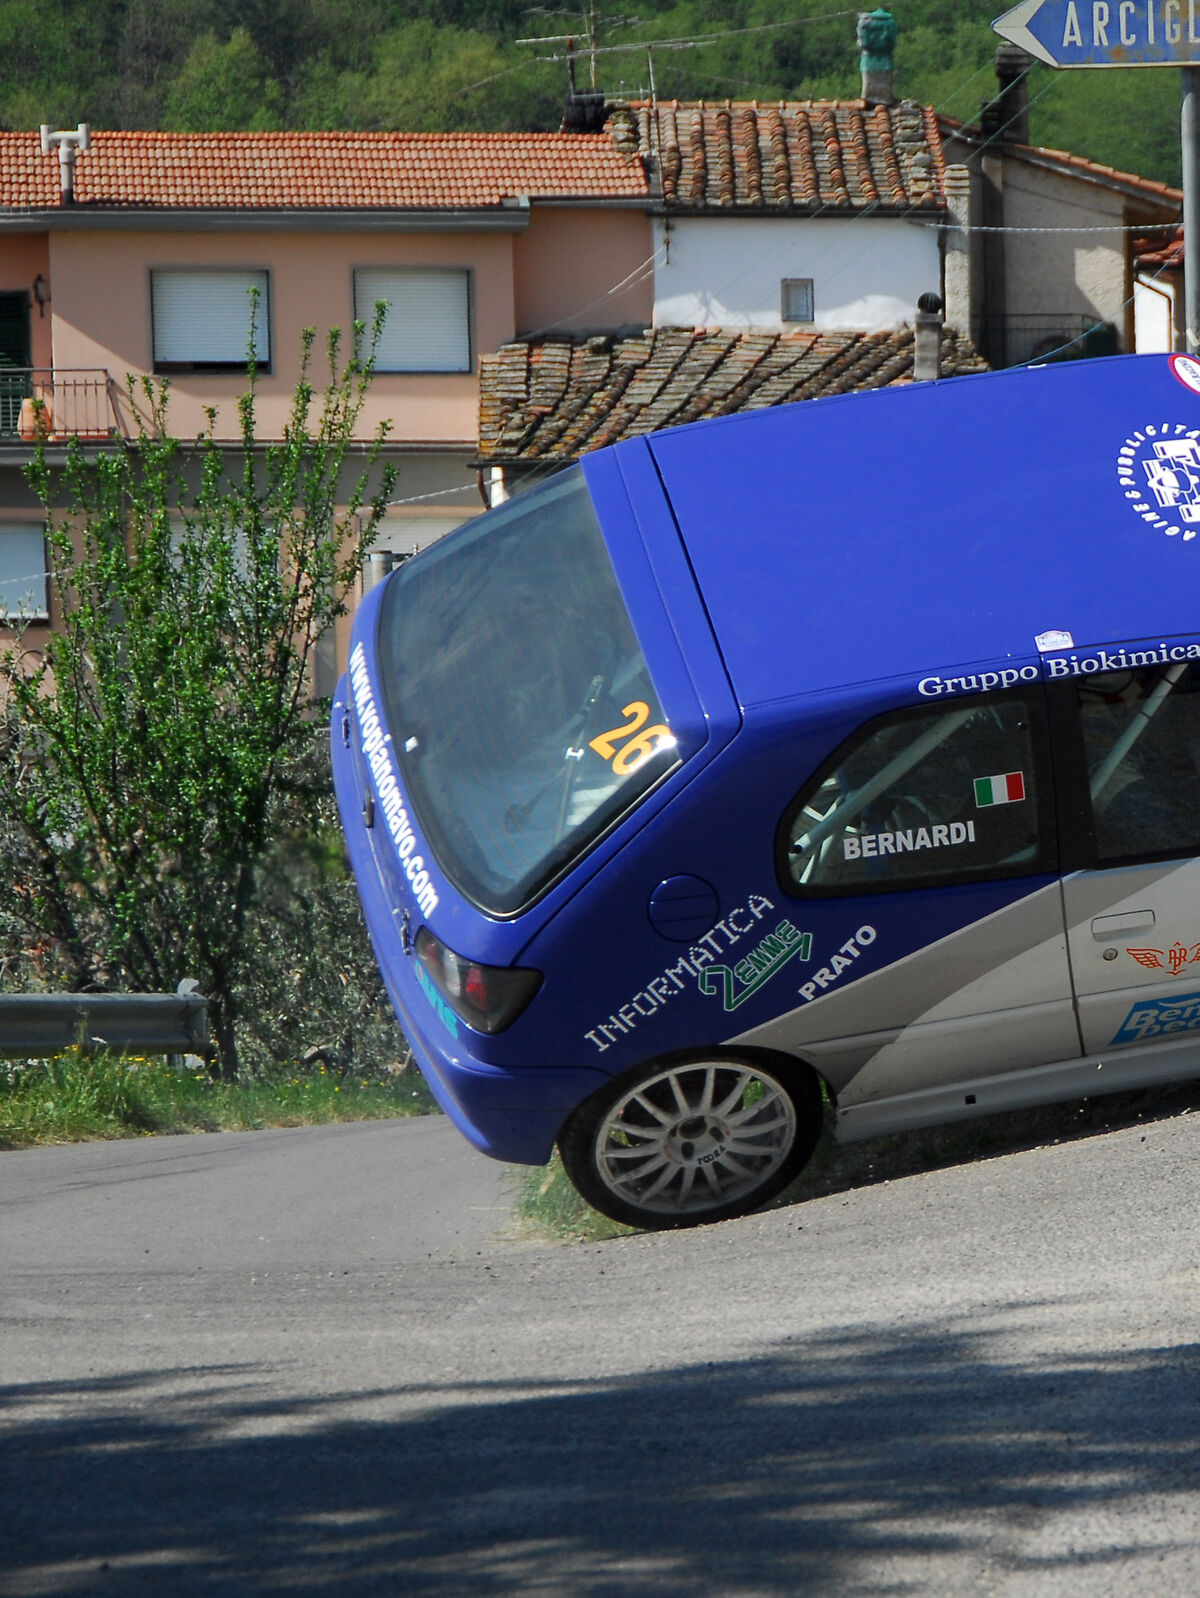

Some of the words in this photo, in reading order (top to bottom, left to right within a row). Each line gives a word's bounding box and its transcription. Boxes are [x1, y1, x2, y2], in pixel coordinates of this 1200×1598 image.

[917, 665, 1038, 696] Gruppo
[588, 701, 674, 776] 26
[350, 641, 440, 920] www.vopianomavo.com
[843, 820, 976, 860] BERNARDI
[584, 894, 774, 1052] INFORMATICA
[798, 925, 877, 1001] PRATO
